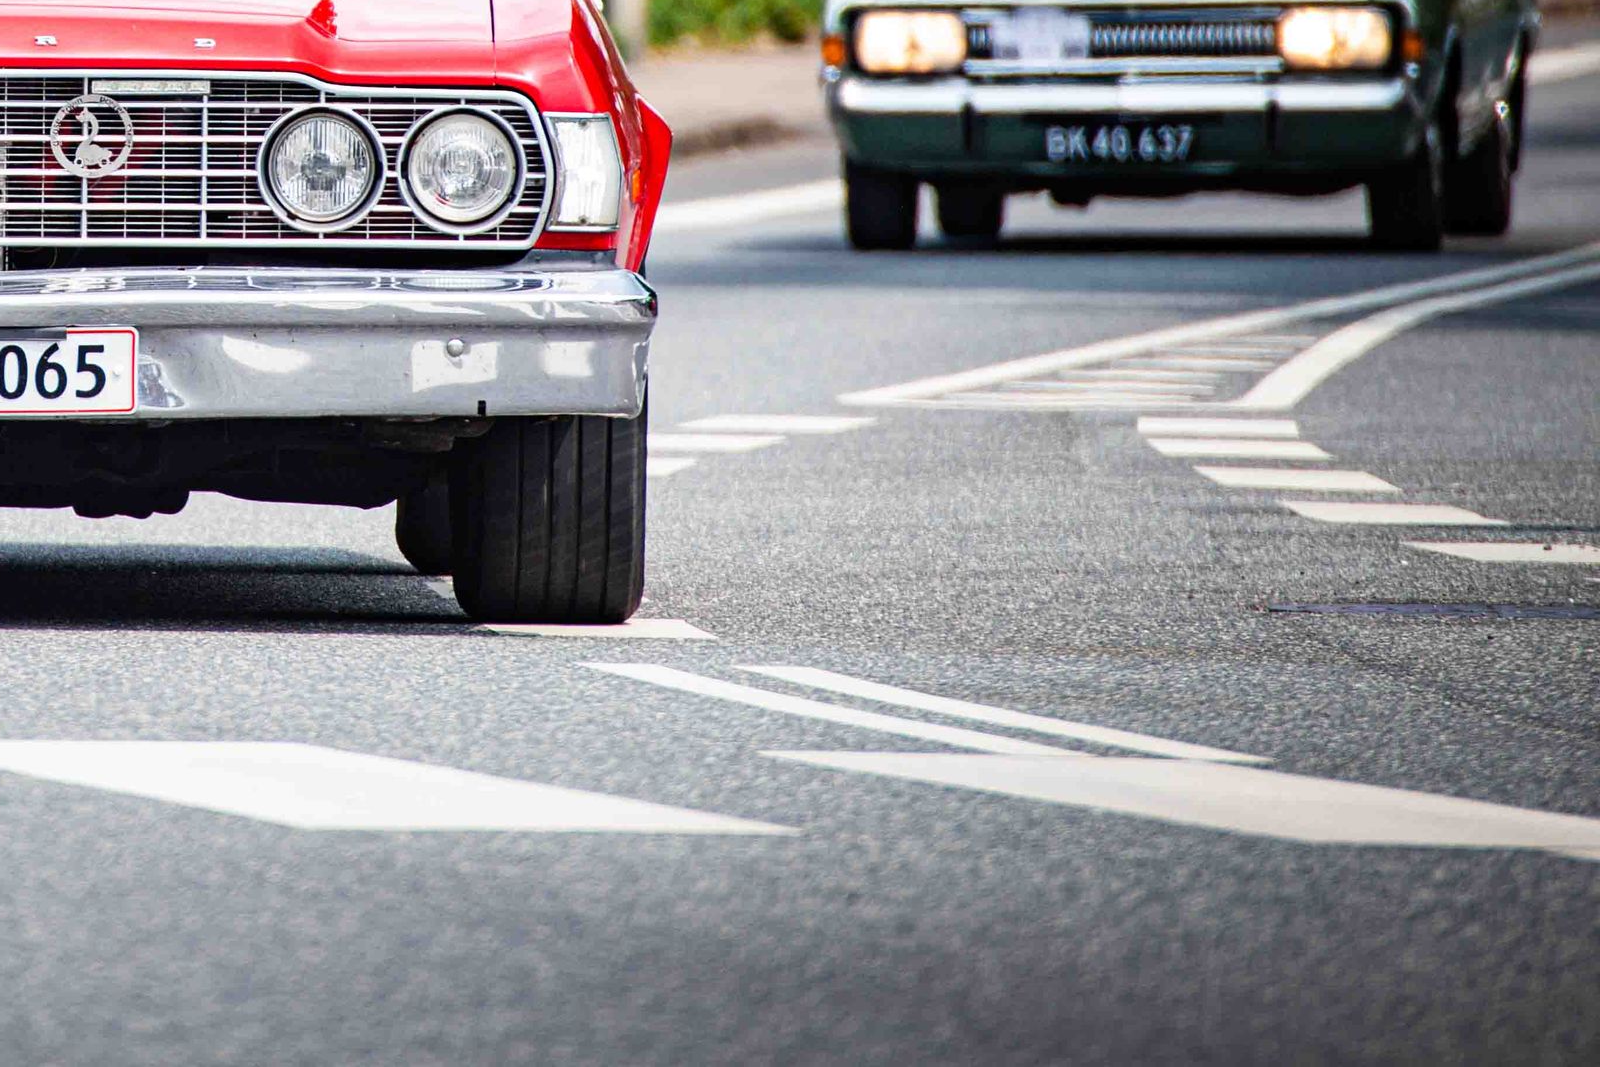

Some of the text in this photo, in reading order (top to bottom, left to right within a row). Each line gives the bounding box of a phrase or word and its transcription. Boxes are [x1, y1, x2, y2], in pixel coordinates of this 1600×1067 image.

[1045, 124, 1193, 162] BK 40 637
